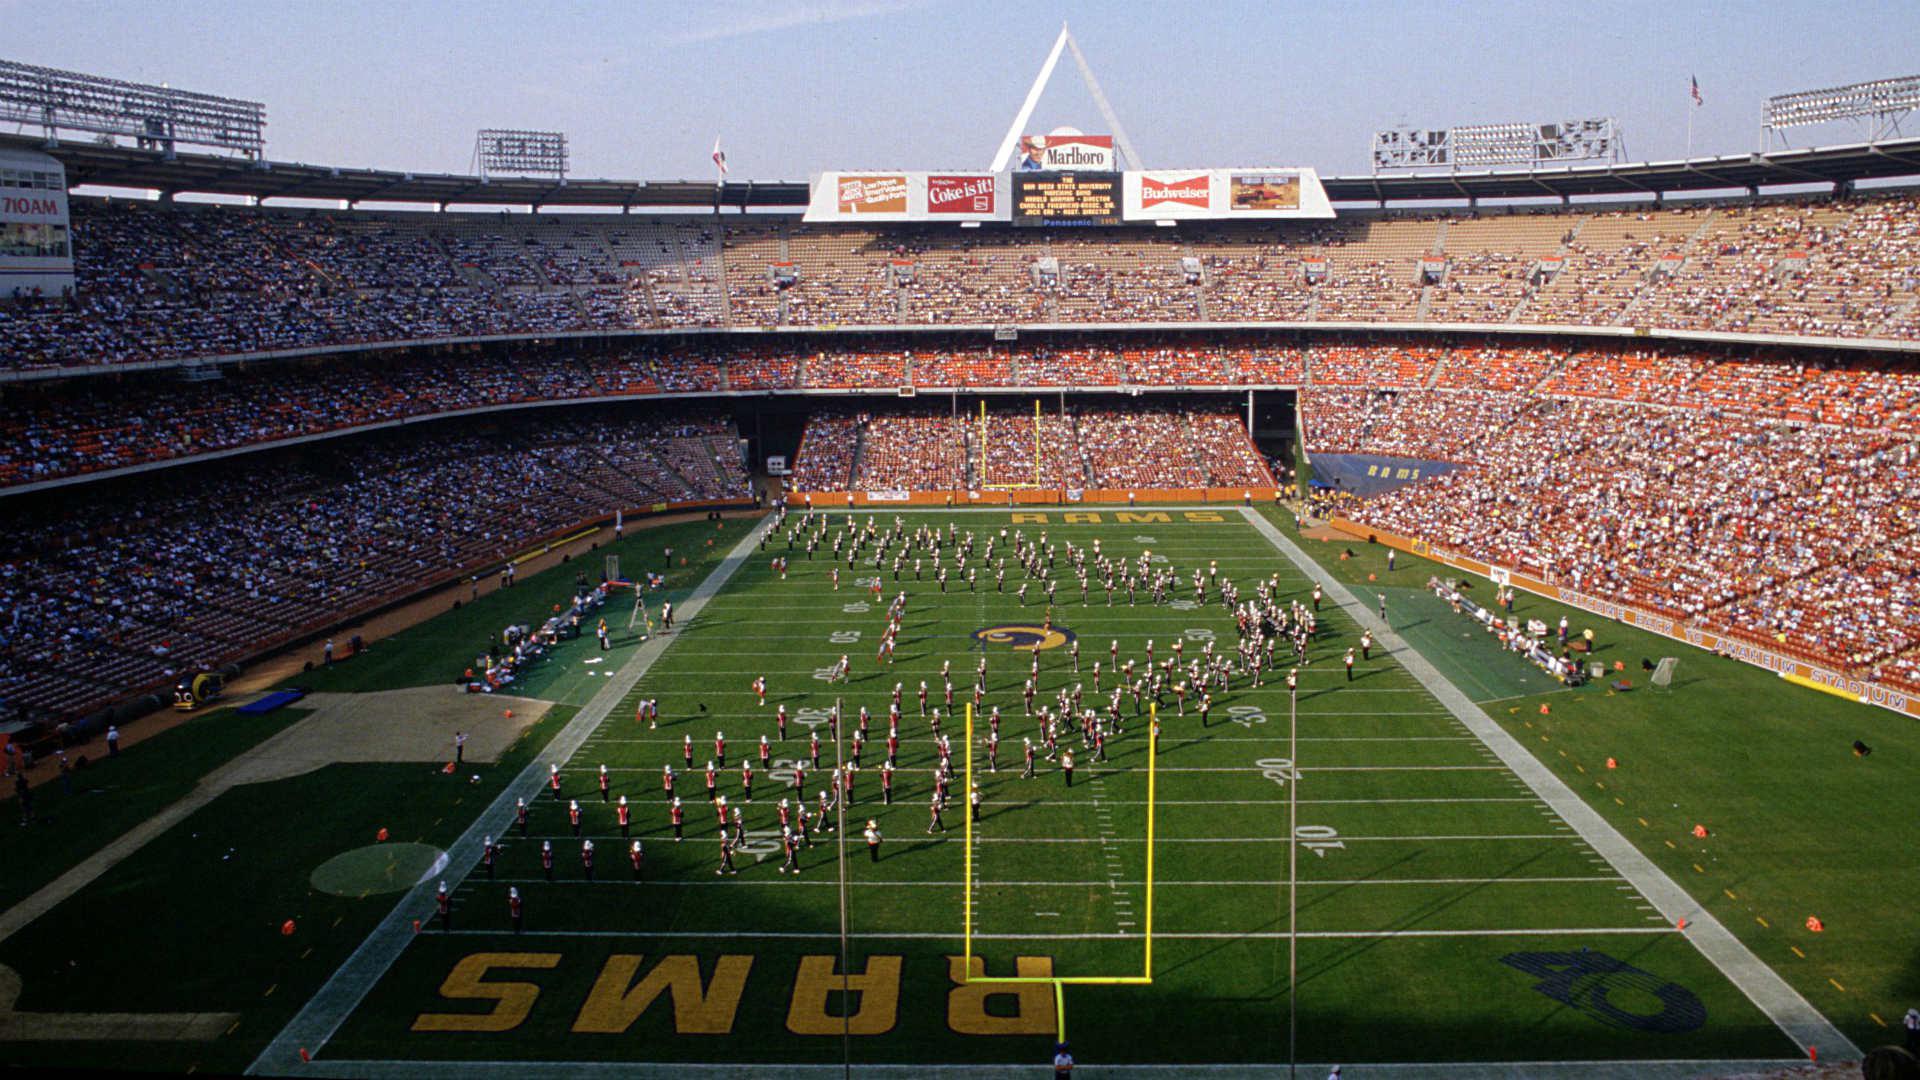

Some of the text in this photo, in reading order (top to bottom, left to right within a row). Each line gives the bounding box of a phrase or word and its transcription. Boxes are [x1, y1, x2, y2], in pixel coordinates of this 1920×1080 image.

[1047, 146, 1104, 165] Marlboro
[930, 179, 993, 205] Coke is it!
[1142, 186, 1210, 199] Budweiser
[1043, 219, 1092, 227] Panasonic
[1011, 511, 1225, 525] RAMS
[829, 630, 862, 644] 50
[1713, 636, 1797, 675] ANAHEIM
[1809, 667, 1907, 710] STADIUM
[1226, 705, 1267, 724] 30
[1255, 757, 1303, 781] 20
[1294, 825, 1346, 850] 10
[409, 952, 1057, 1035] RAMS
